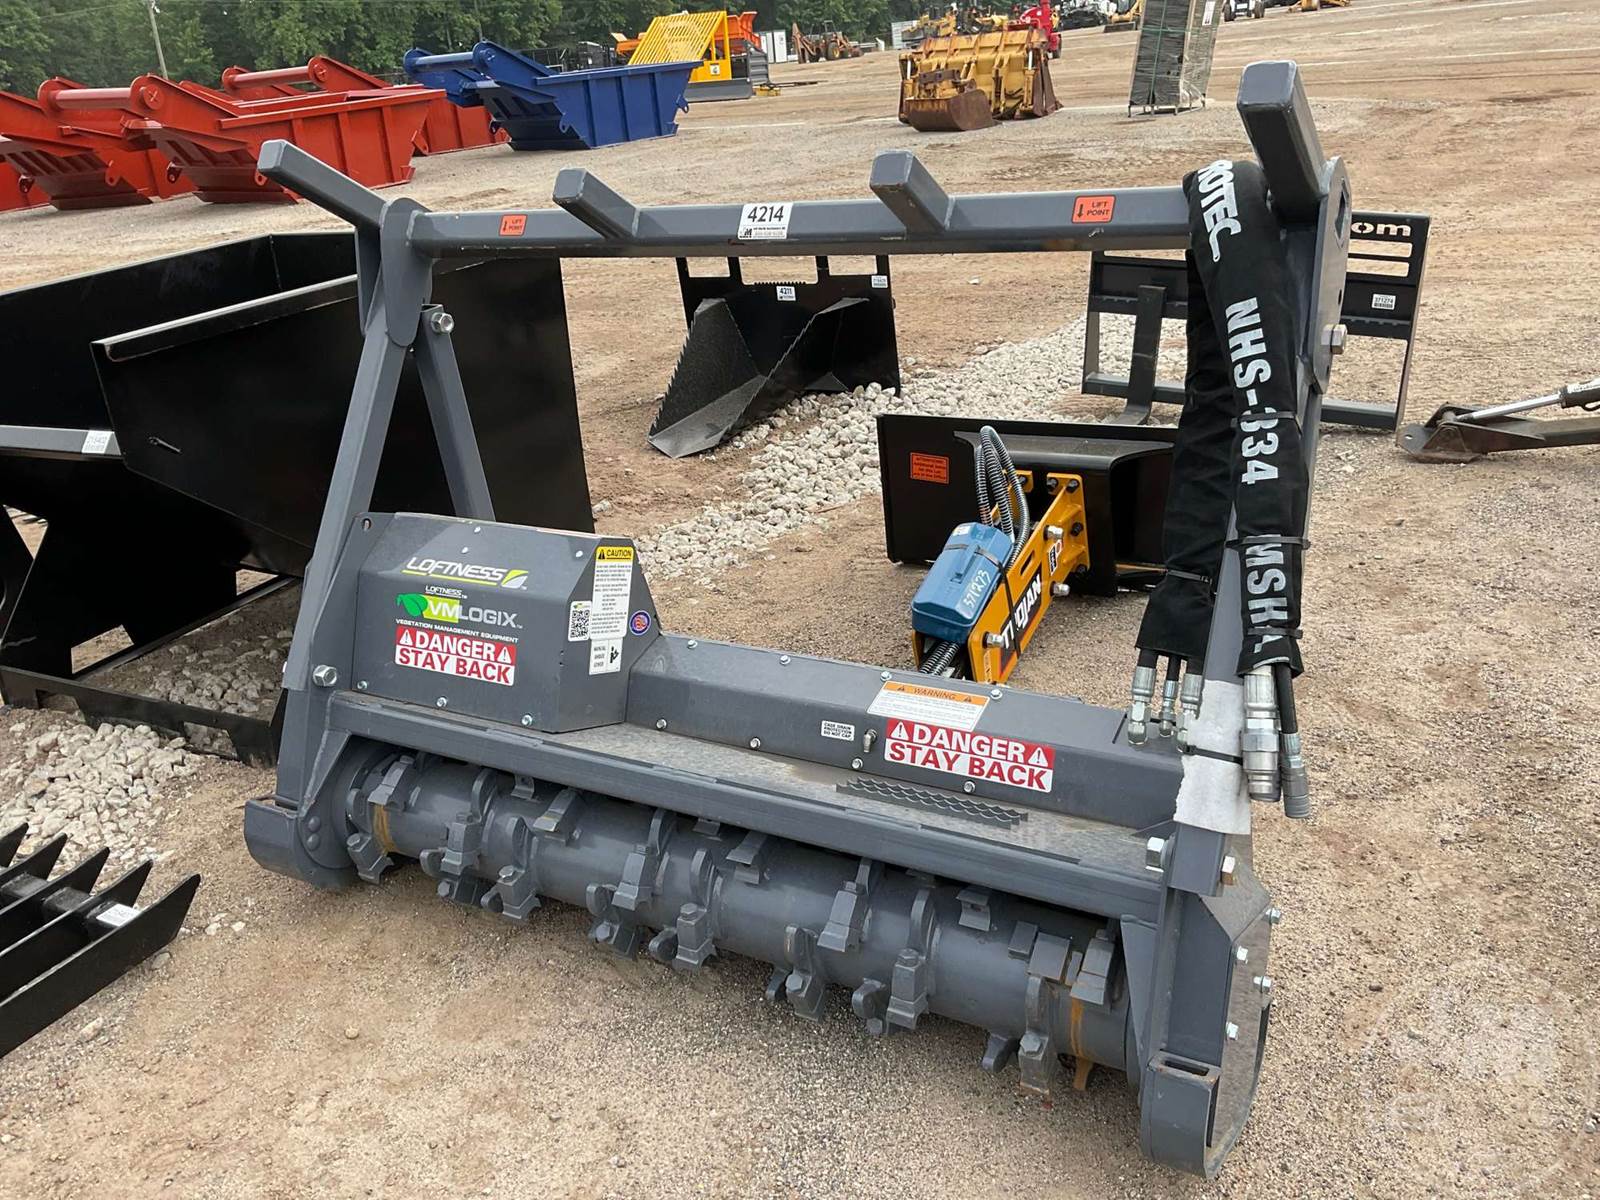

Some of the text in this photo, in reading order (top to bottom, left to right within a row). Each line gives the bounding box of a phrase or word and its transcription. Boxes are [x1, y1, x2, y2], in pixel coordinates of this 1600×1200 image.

[747, 205, 784, 223] 4214
[1350, 222, 1411, 237] om
[1225, 297, 1279, 485] NHS-334
[606, 549, 632, 557] CAUTION
[406, 557, 508, 581] LOFTNESS
[425, 585, 463, 596] LOFTNESS
[429, 601, 518, 629] VMLOGIX
[396, 619, 519, 643] VEGETATION MANAGEMENT EQUIPMENT
[415, 630, 496, 662] DANGER
[399, 648, 511, 684] STAY BACK
[913, 687, 957, 700] WARNING
[912, 723, 1026, 764] DANGER
[889, 741, 1049, 791] STAY BACK
